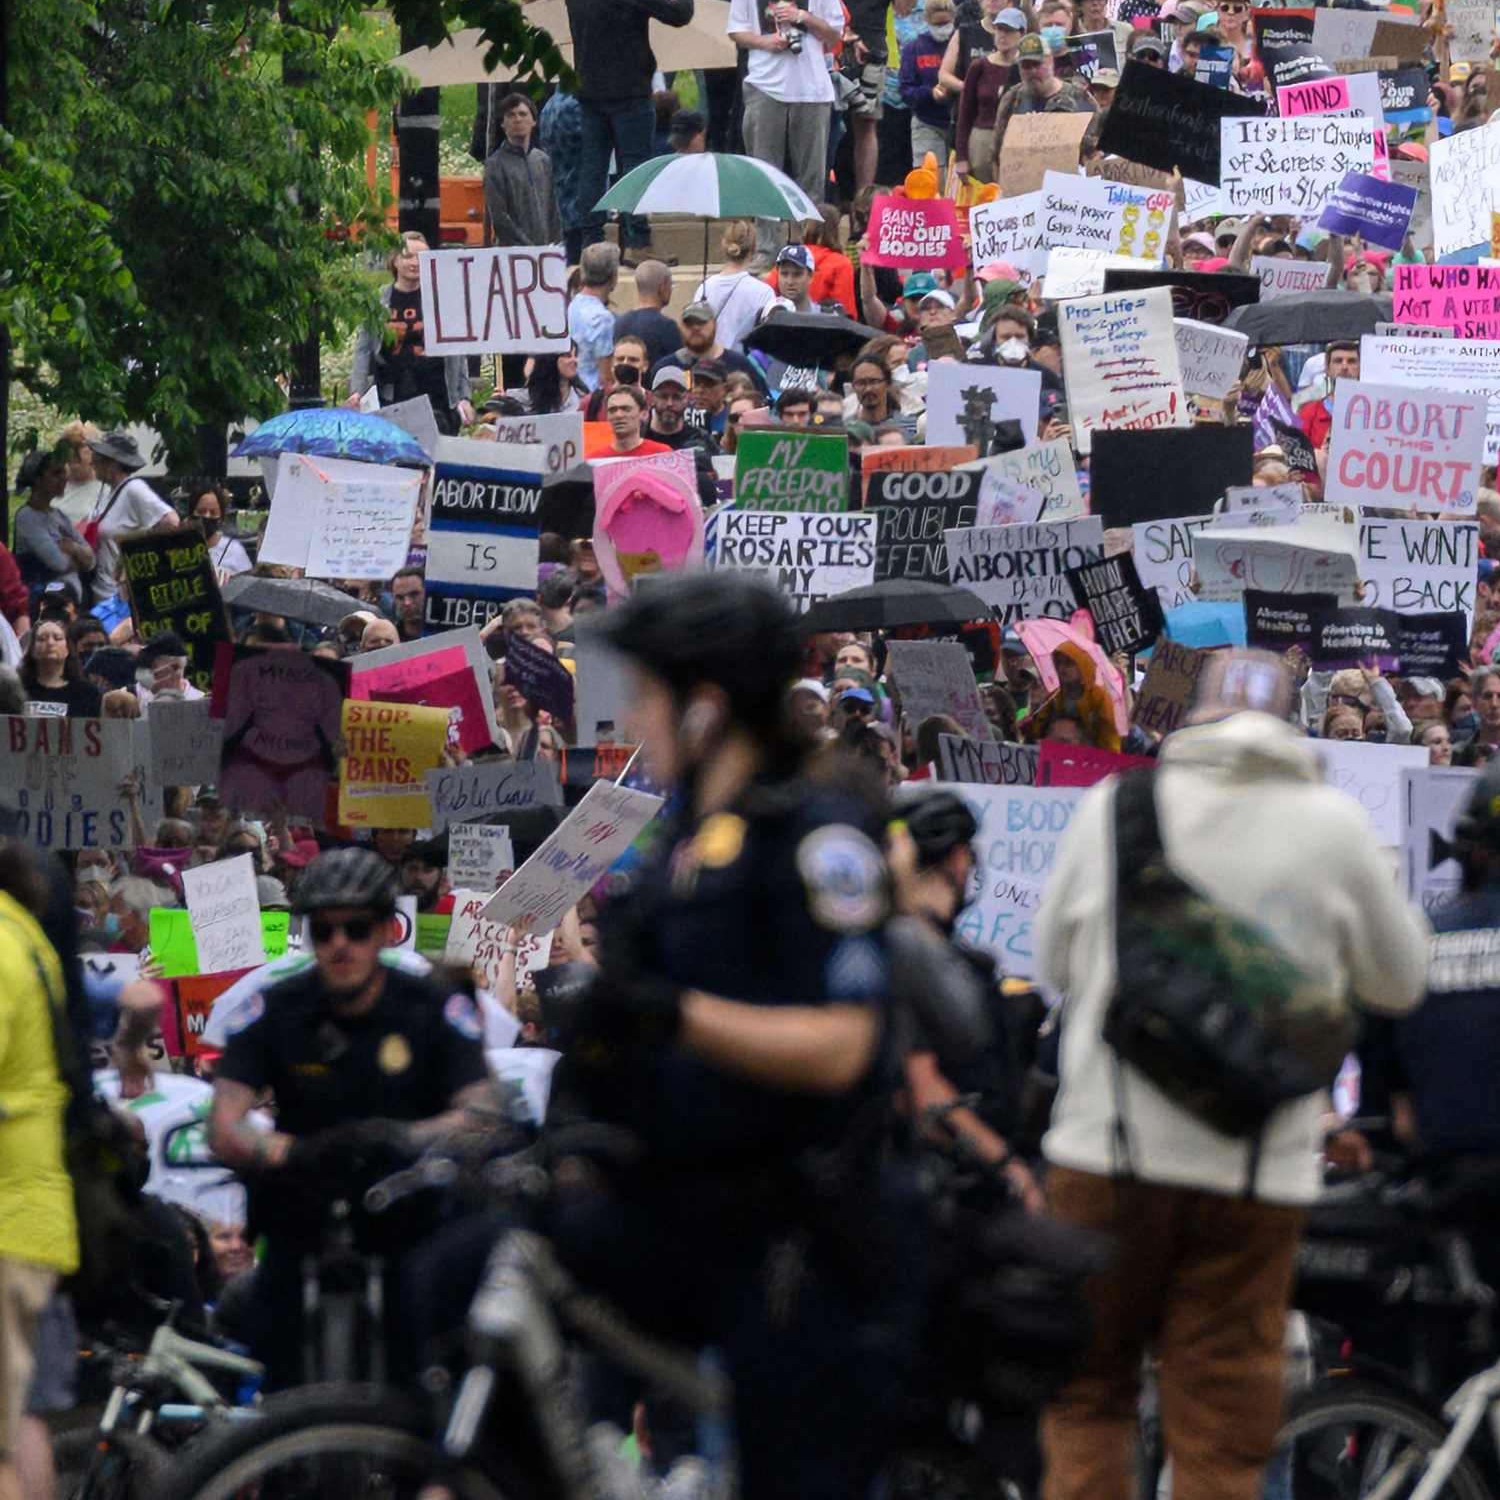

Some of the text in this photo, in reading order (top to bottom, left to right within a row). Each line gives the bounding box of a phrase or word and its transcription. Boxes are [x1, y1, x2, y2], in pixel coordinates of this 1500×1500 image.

[1286, 85, 1342, 114] MIND
[1239, 121, 1276, 143] It's
[881, 208, 925, 227] BANS
[880, 224, 951, 241] OFF OUR
[879, 239, 946, 257] BODIES
[1399, 266, 1423, 291] HE
[1427, 266, 1468, 286] WHO
[429, 251, 568, 343] LIARS
[1398, 298, 1433, 319] NOT
[1444, 298, 1459, 320] A
[1345, 394, 1473, 441] ABORT
[768, 441, 808, 464] MY
[1387, 438, 1435, 451] THIS
[740, 469, 846, 496] FREEDOM
[882, 470, 970, 500] GOOD
[1339, 449, 1471, 502] COURT
[433, 479, 540, 512] ABORTION
[726, 515, 871, 537] KEEP YOUR
[466, 544, 497, 570] IS
[720, 537, 875, 565] ROSARIES
[1400, 524, 1476, 565] WON'T
[952, 545, 1106, 582] ABORTION
[778, 567, 810, 592] MY
[1391, 579, 1472, 611] BACK
[348, 705, 413, 725] STOP.
[347, 726, 396, 752] THE.
[347, 754, 418, 780] BANS.
